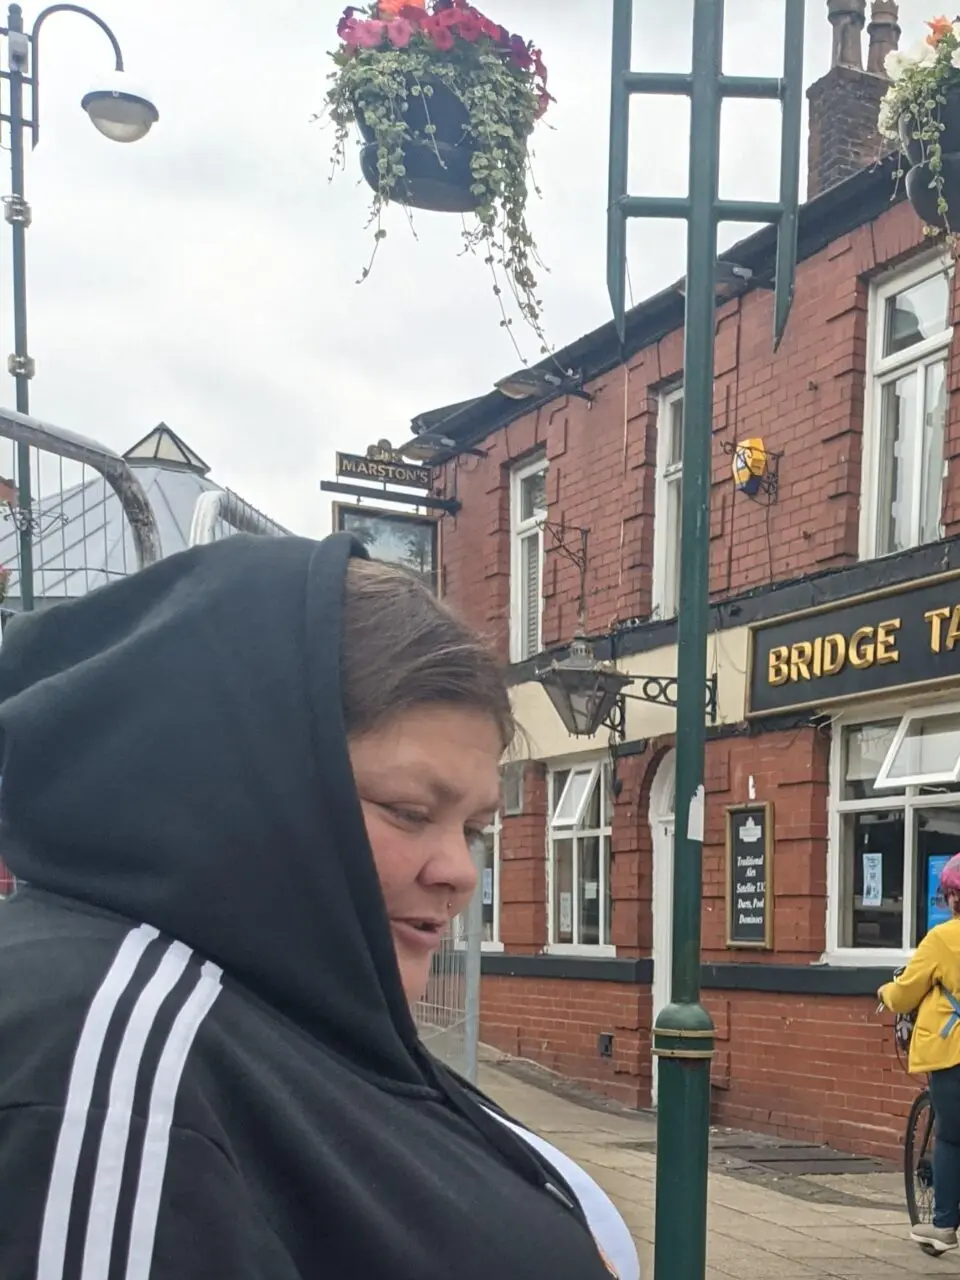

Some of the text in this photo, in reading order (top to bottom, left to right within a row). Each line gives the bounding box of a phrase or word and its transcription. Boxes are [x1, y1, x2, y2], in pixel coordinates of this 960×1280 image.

[342, 458, 429, 484] MARSTON'S
[767, 617, 901, 687] BRIDGE
[736, 854, 764, 867] Traditional
[736, 882, 756, 894] Satellite
[738, 913, 764, 925] Dominoes
